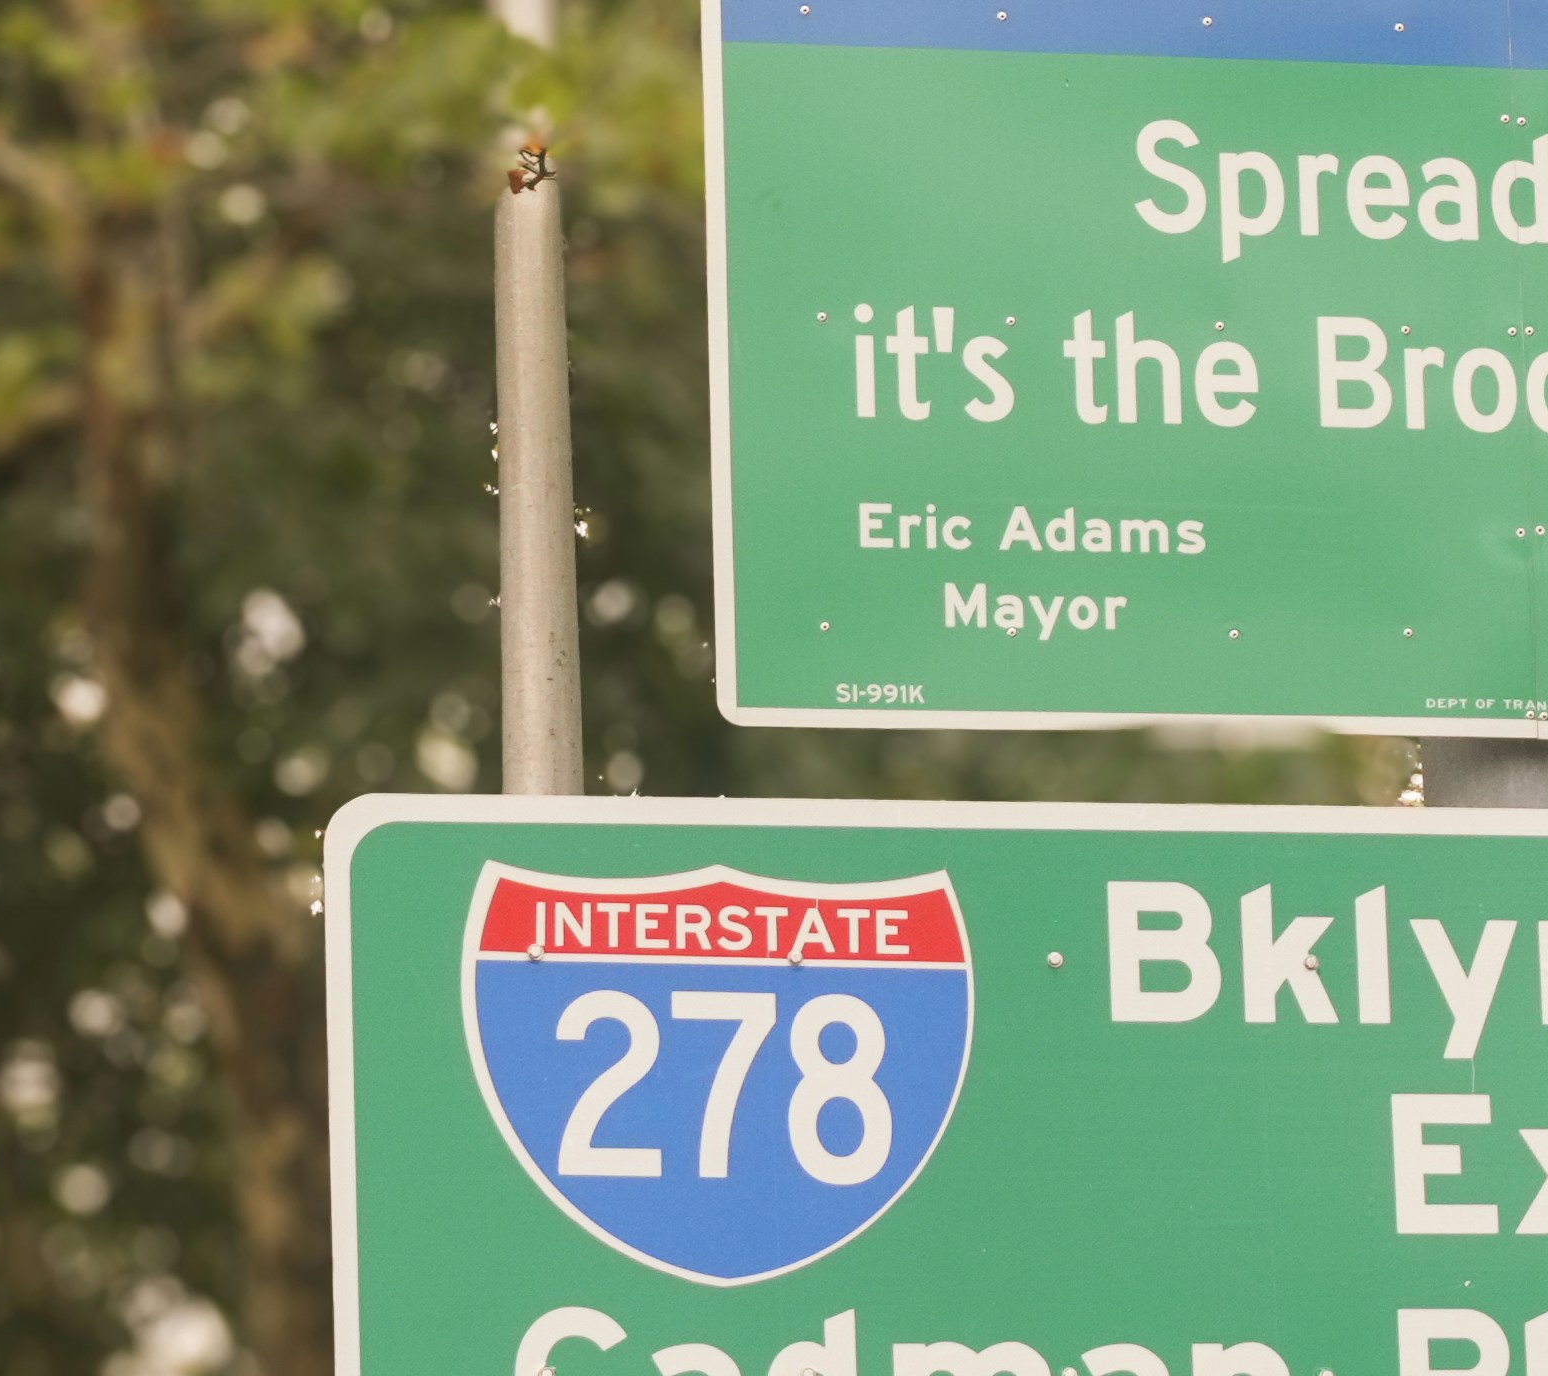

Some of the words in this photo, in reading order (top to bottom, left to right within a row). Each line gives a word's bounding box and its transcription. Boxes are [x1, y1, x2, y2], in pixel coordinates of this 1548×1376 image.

[854, 303, 1014, 422] it's
[1064, 310, 1258, 427] the
[859, 503, 971, 550] Eric
[1000, 506, 1206, 554] Adams
[945, 583, 1127, 640] Mayor
[836, 684, 925, 704] SI-991K
[1426, 698, 1468, 709] DEPT
[1475, 699, 1496, 709] OF
[534, 900, 910, 956] INTERSTATE
[555, 990, 892, 1186] 278
